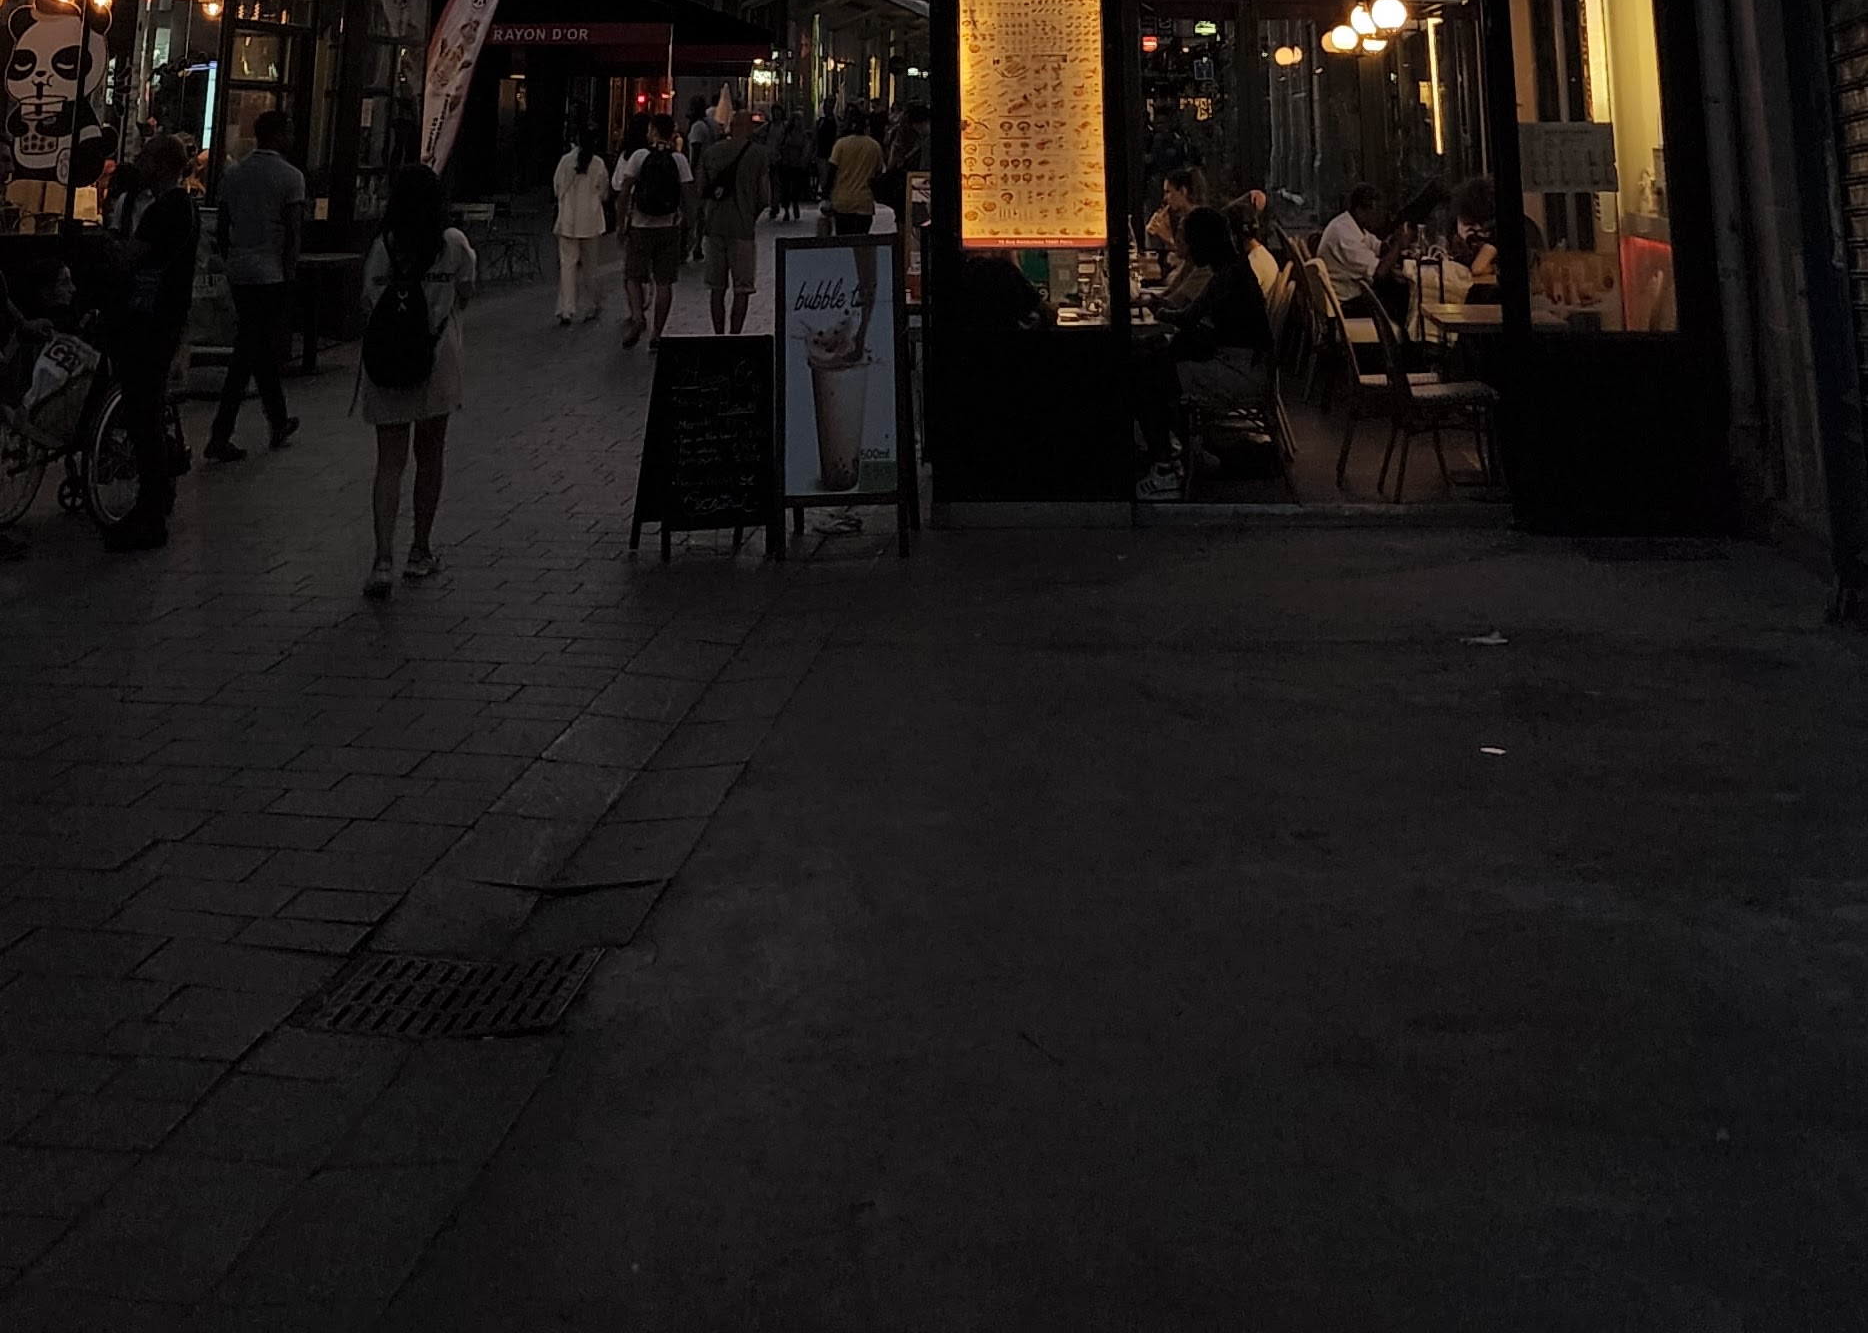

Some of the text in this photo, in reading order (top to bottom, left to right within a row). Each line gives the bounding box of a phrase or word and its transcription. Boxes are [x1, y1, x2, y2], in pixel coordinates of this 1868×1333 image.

[493, 28, 589, 41] RAYON D'OR
[794, 277, 846, 311] bubble
